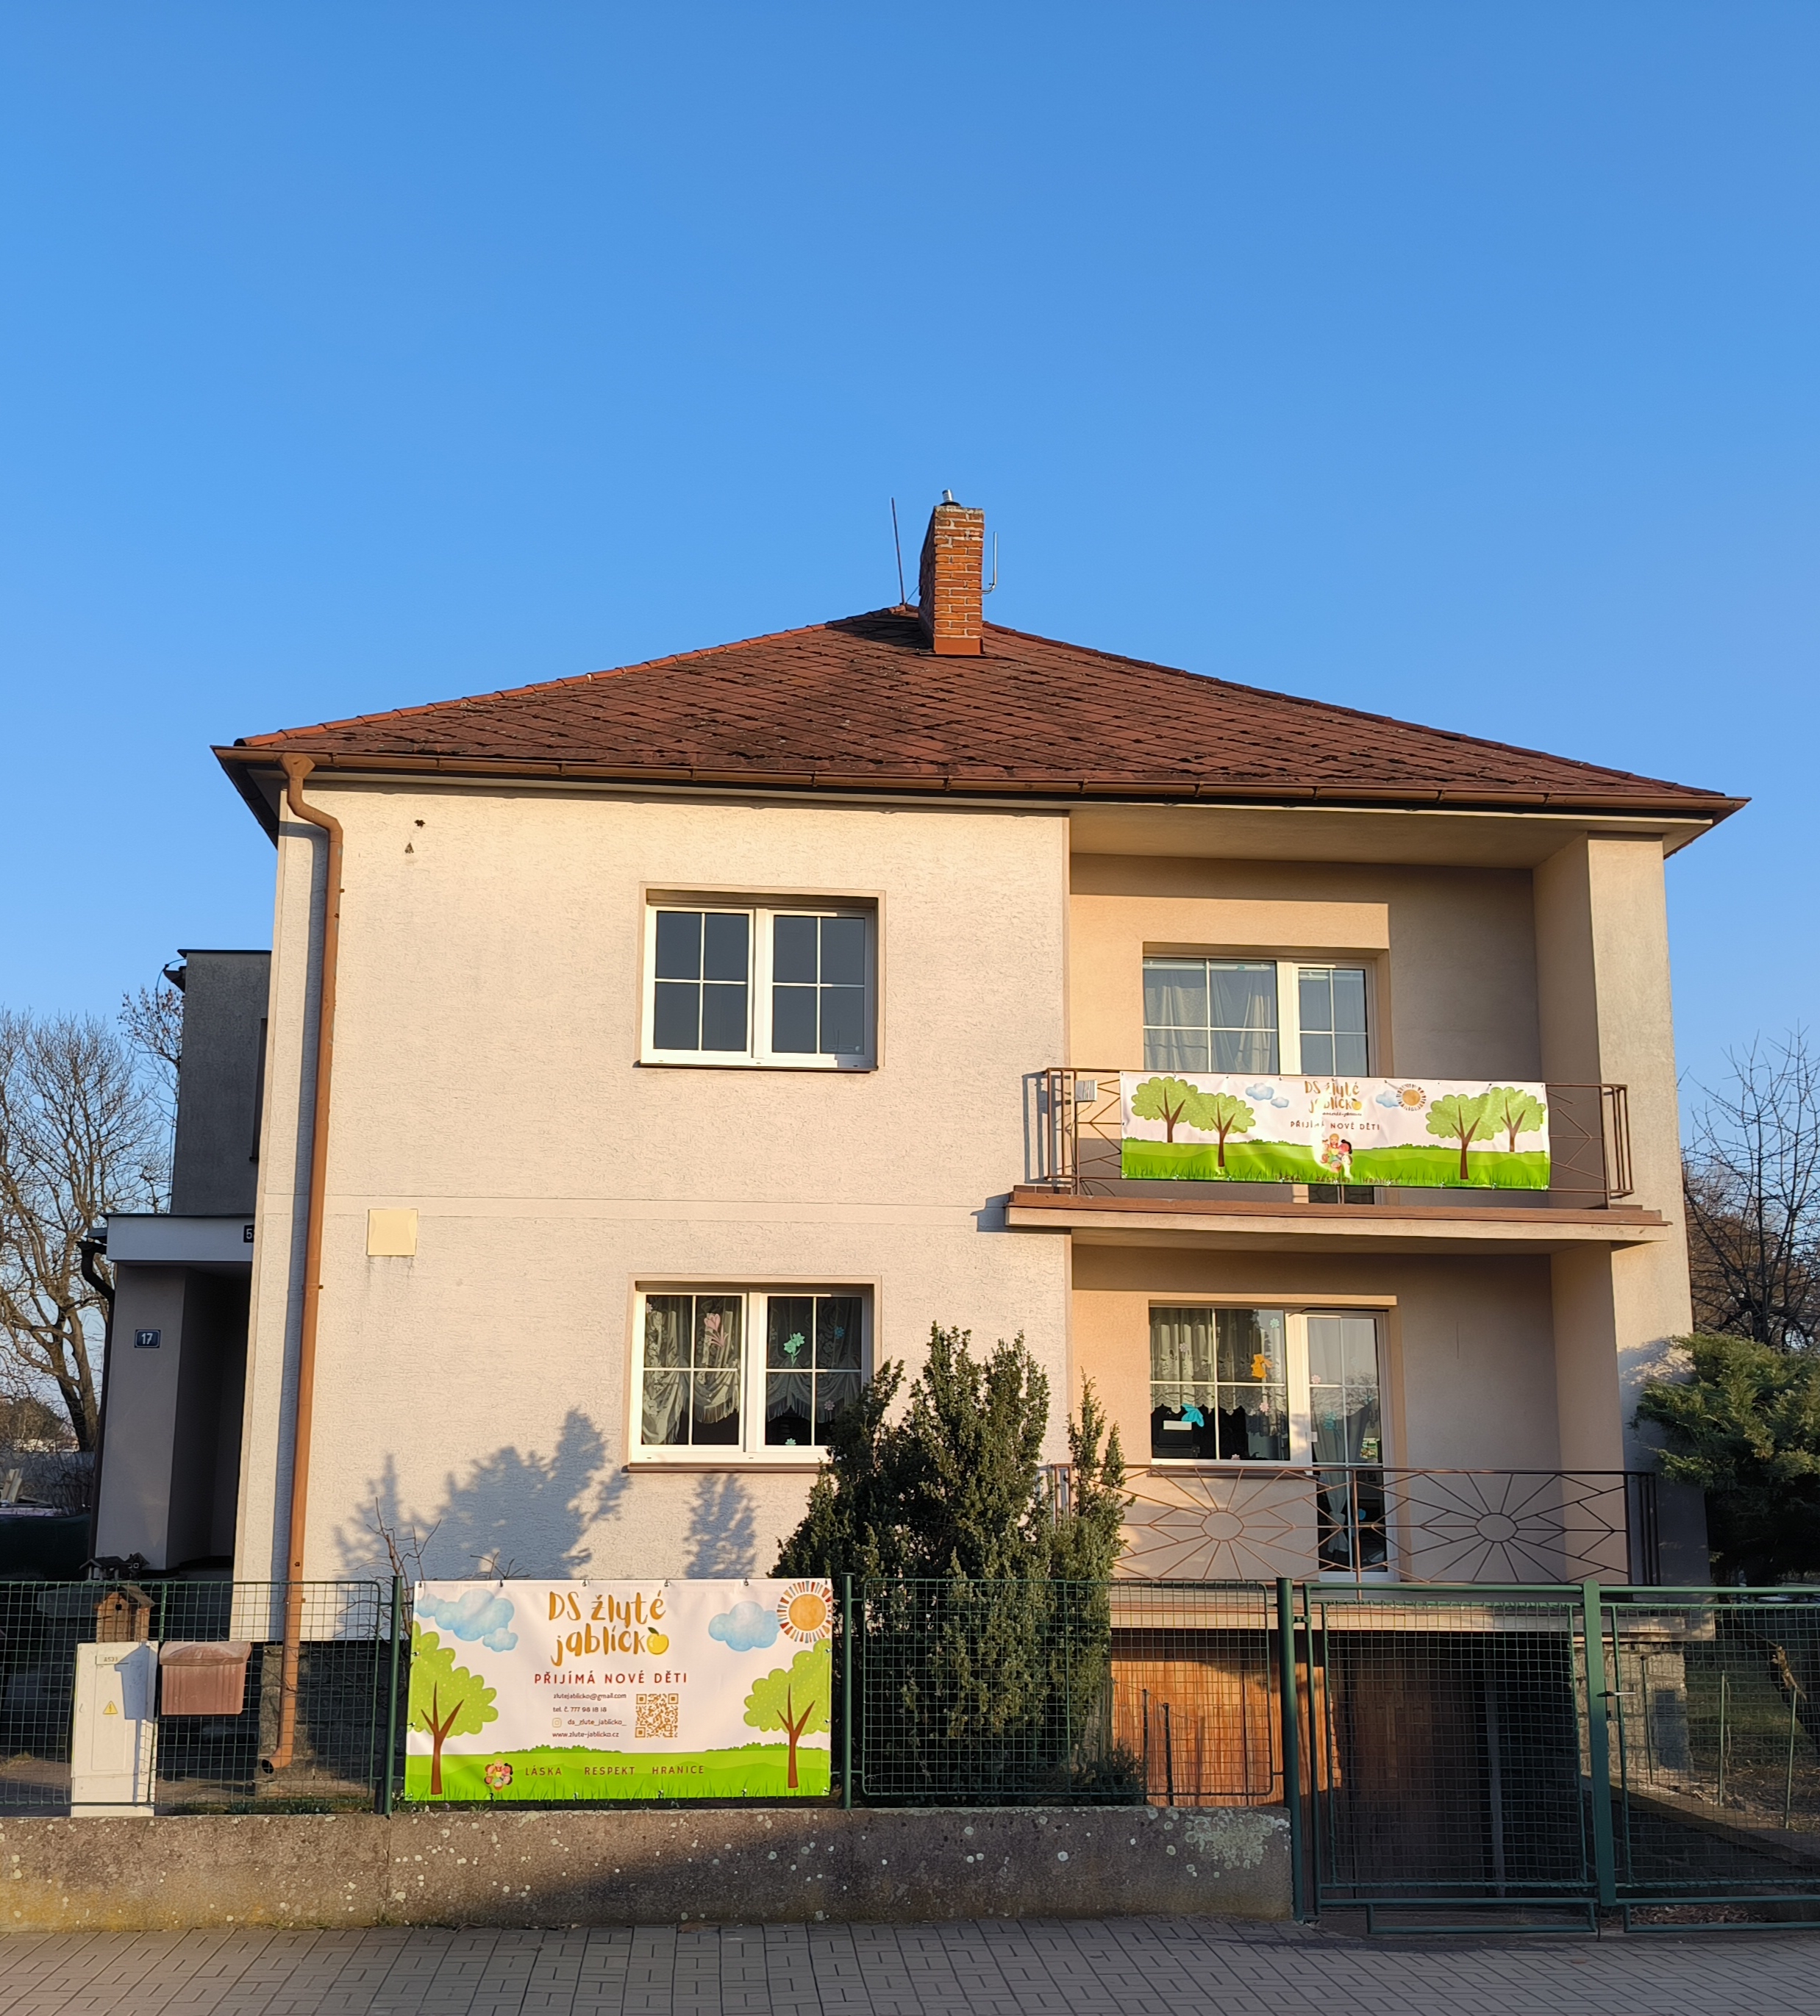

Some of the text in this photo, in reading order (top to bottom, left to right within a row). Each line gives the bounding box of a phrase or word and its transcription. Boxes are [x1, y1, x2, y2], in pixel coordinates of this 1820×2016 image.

[1305, 1080, 1321, 1094] DS
[1330, 1121, 1355, 1130] NOVÉ
[1360, 1122, 1380, 1131] DĚTI
[141, 1332, 153, 1345] 17
[549, 1590, 666, 1629] DS žlyté
[534, 1670, 687, 1684] PŘIJÍMÁ NOVÉ DĚTI
[552, 1731, 620, 1739] www.zlute-jablicko.cz
[525, 1765, 704, 1776] LÁSKA RESPEKT HRANICE
